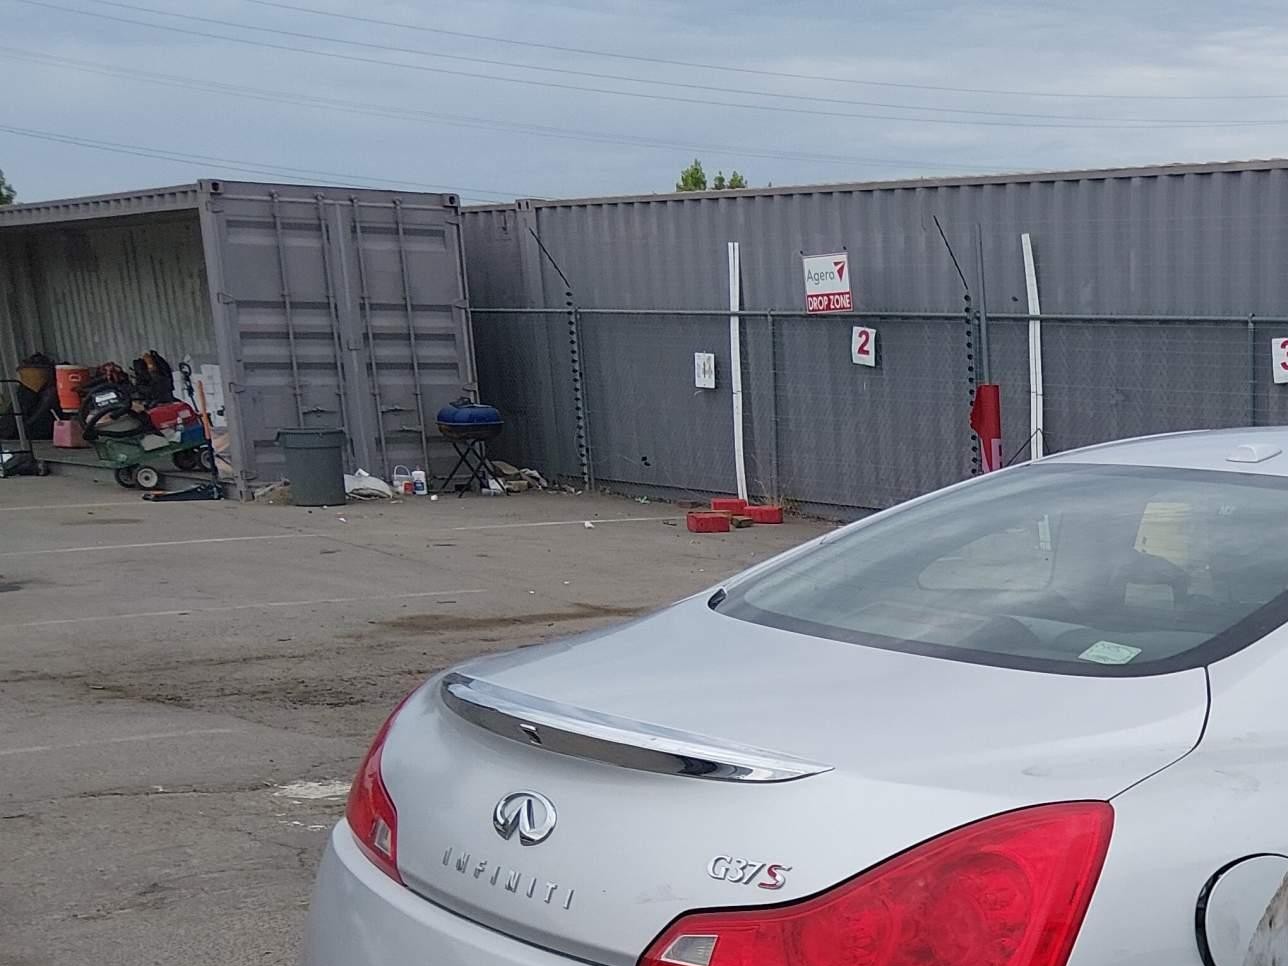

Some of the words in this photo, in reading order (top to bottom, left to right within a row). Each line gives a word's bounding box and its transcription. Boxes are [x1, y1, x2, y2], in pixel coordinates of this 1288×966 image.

[806, 269, 835, 285] Agero
[807, 295, 828, 311] DROP
[829, 293, 851, 310] ZONE
[857, 329, 870, 356] 2
[441, 847, 576, 911] INFINITI
[707, 855, 793, 890] G37S
